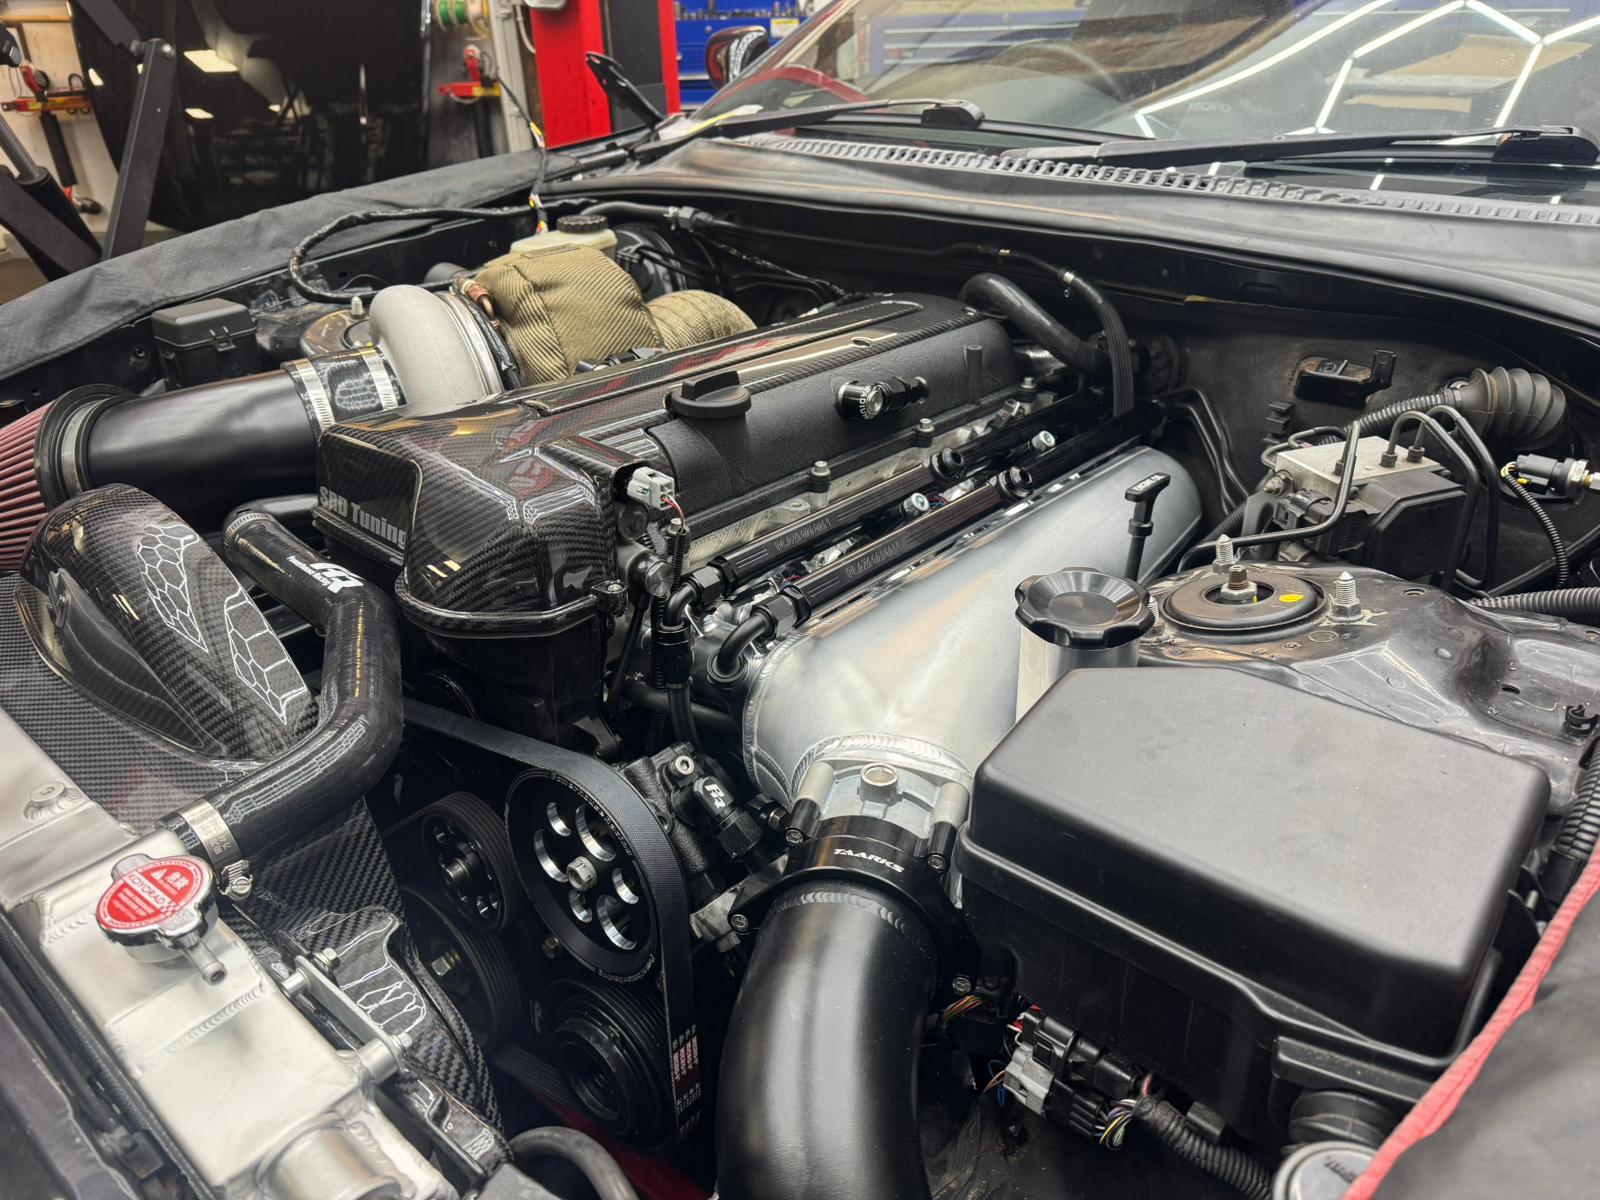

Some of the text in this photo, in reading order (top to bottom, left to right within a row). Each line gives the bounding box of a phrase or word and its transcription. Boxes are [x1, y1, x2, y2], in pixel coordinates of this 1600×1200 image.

[319, 486, 407, 550] SRD Tuning
[833, 848, 905, 873] TAARKS
[127, 873, 166, 905] KOYORAD
